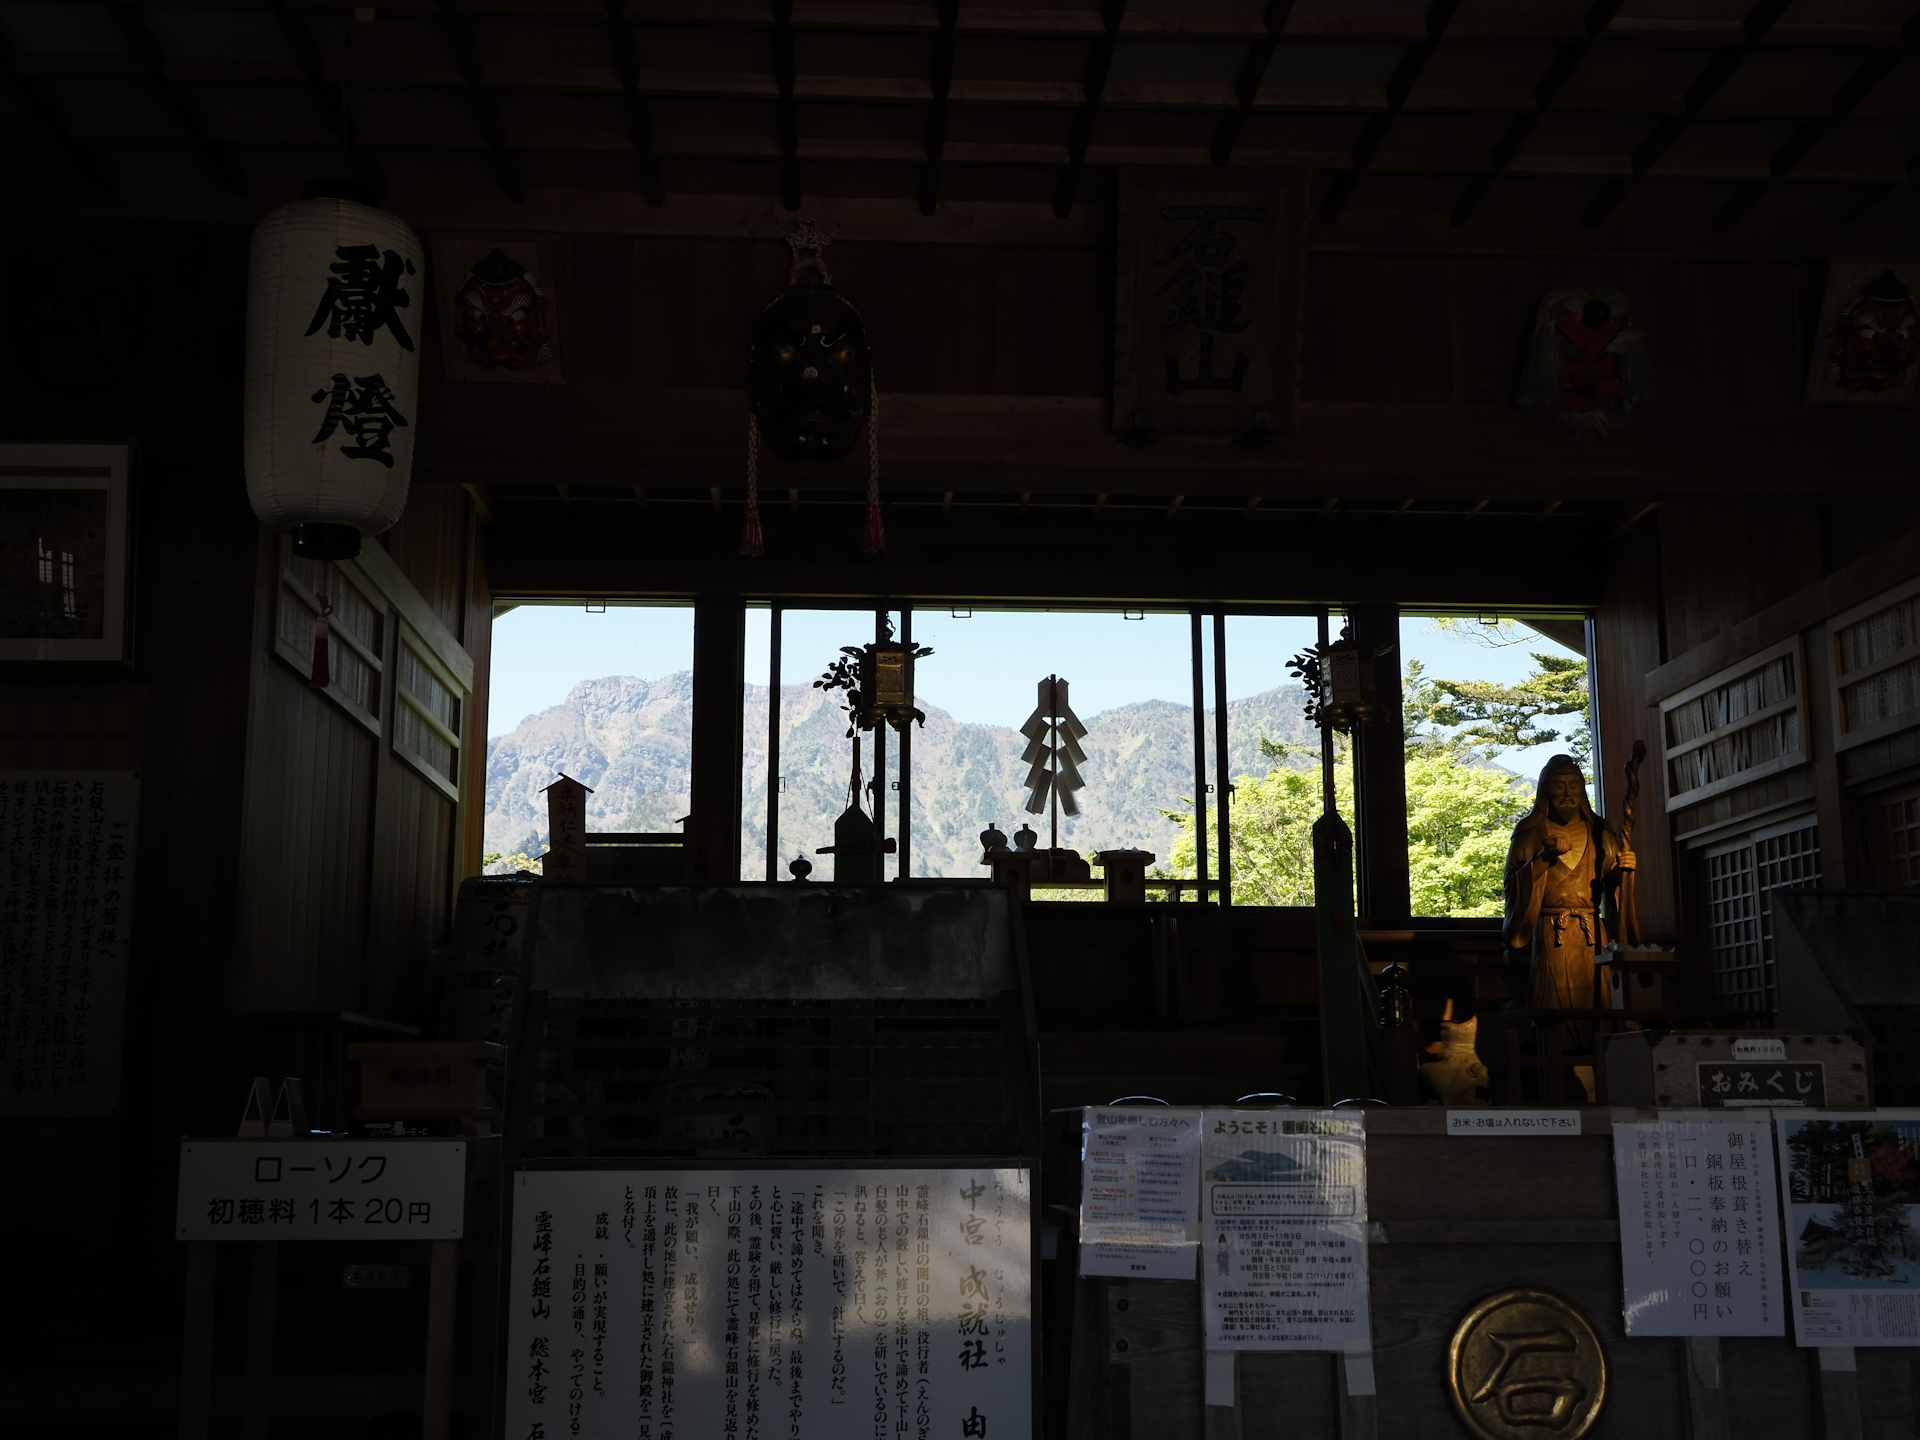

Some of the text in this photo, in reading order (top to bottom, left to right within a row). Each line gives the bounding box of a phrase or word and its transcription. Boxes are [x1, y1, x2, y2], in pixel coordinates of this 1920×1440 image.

[1153, 206, 1267, 394] 石鎚山
[98, 823, 127, 959] ご登拝の皆様へ
[1453, 1118, 1575, 1127] お米・お塩は入れないで下さい
[1712, 1070, 1813, 1094] おみくじ
[207, 1198, 430, 1225] 初穂料 1本 20円
[255, 1156, 387, 1184] ローソク
[594, 1212, 609, 1240] 成就
[621, 1186, 636, 1249] と名付く。
[811, 1185, 826, 1258] これを聞き、
[1727, 1132, 1753, 1276] 御屋根葺き替え
[1705, 1153, 1732, 1318] 銅板奉納のお願い
[526, 1210, 553, 1440] 霊峰石鎚山 総本宮 石
[788, 1192, 805, 1440] 「途中で諦めてはならぬ。最後までやり
[873, 1184, 889, 1440] 白髪の老人が斧（おの）を研いでいるのに
[957, 1178, 990, 1440] 中宮 成就社 由
[1471, 1327, 1588, 1431] 石
